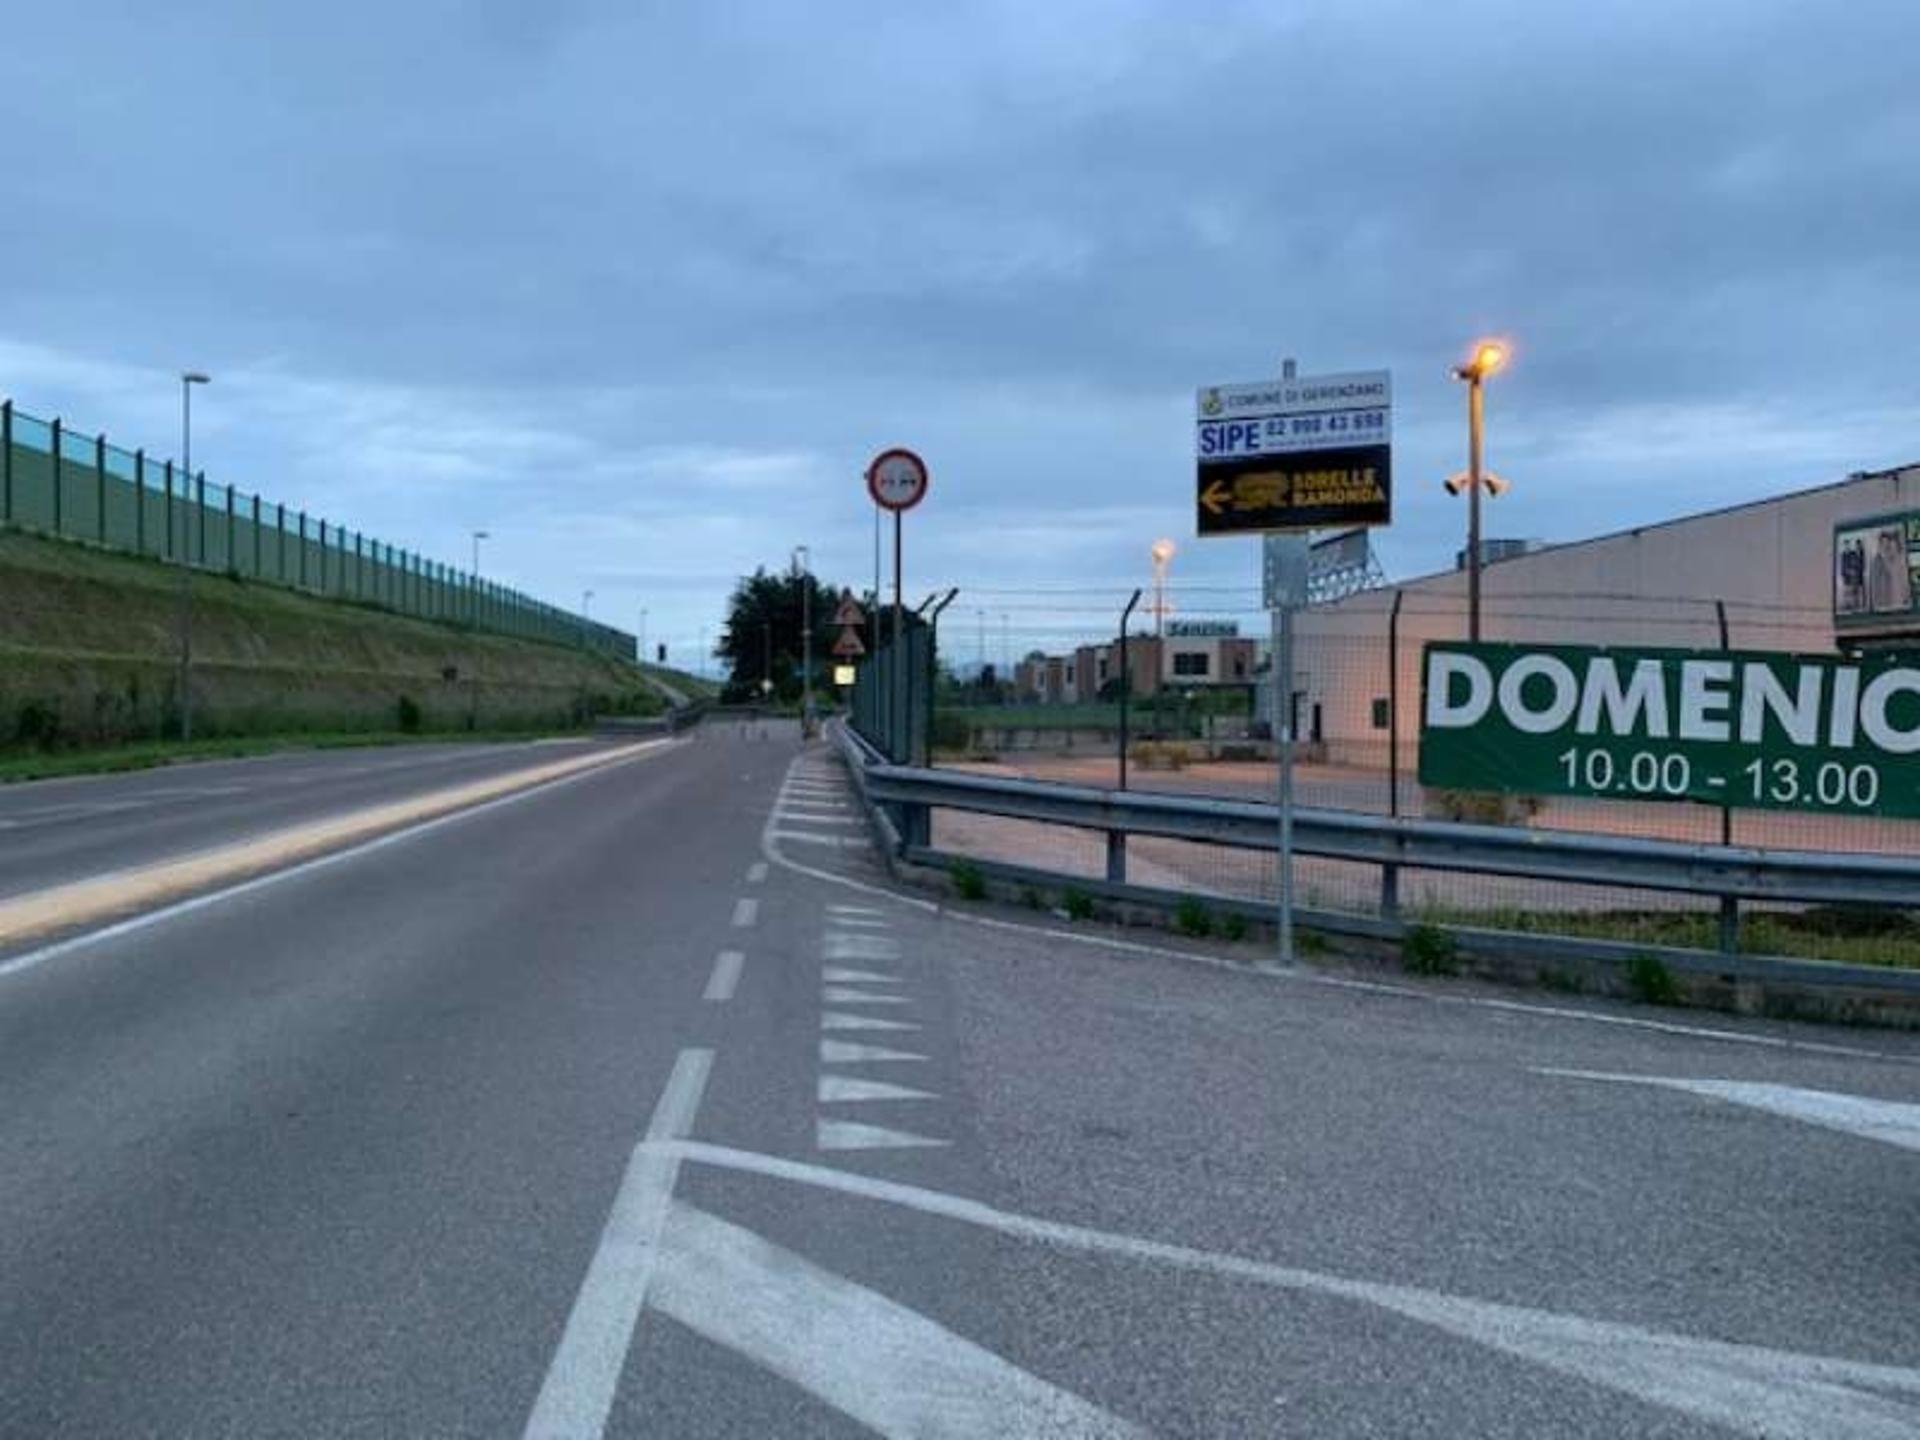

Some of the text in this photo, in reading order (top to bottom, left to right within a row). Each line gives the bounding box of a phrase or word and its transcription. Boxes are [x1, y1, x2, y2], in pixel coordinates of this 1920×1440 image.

[1201, 422, 1260, 454] SIPE
[1558, 747, 1691, 796] 10.00
[1744, 757, 1879, 808] 13.00
